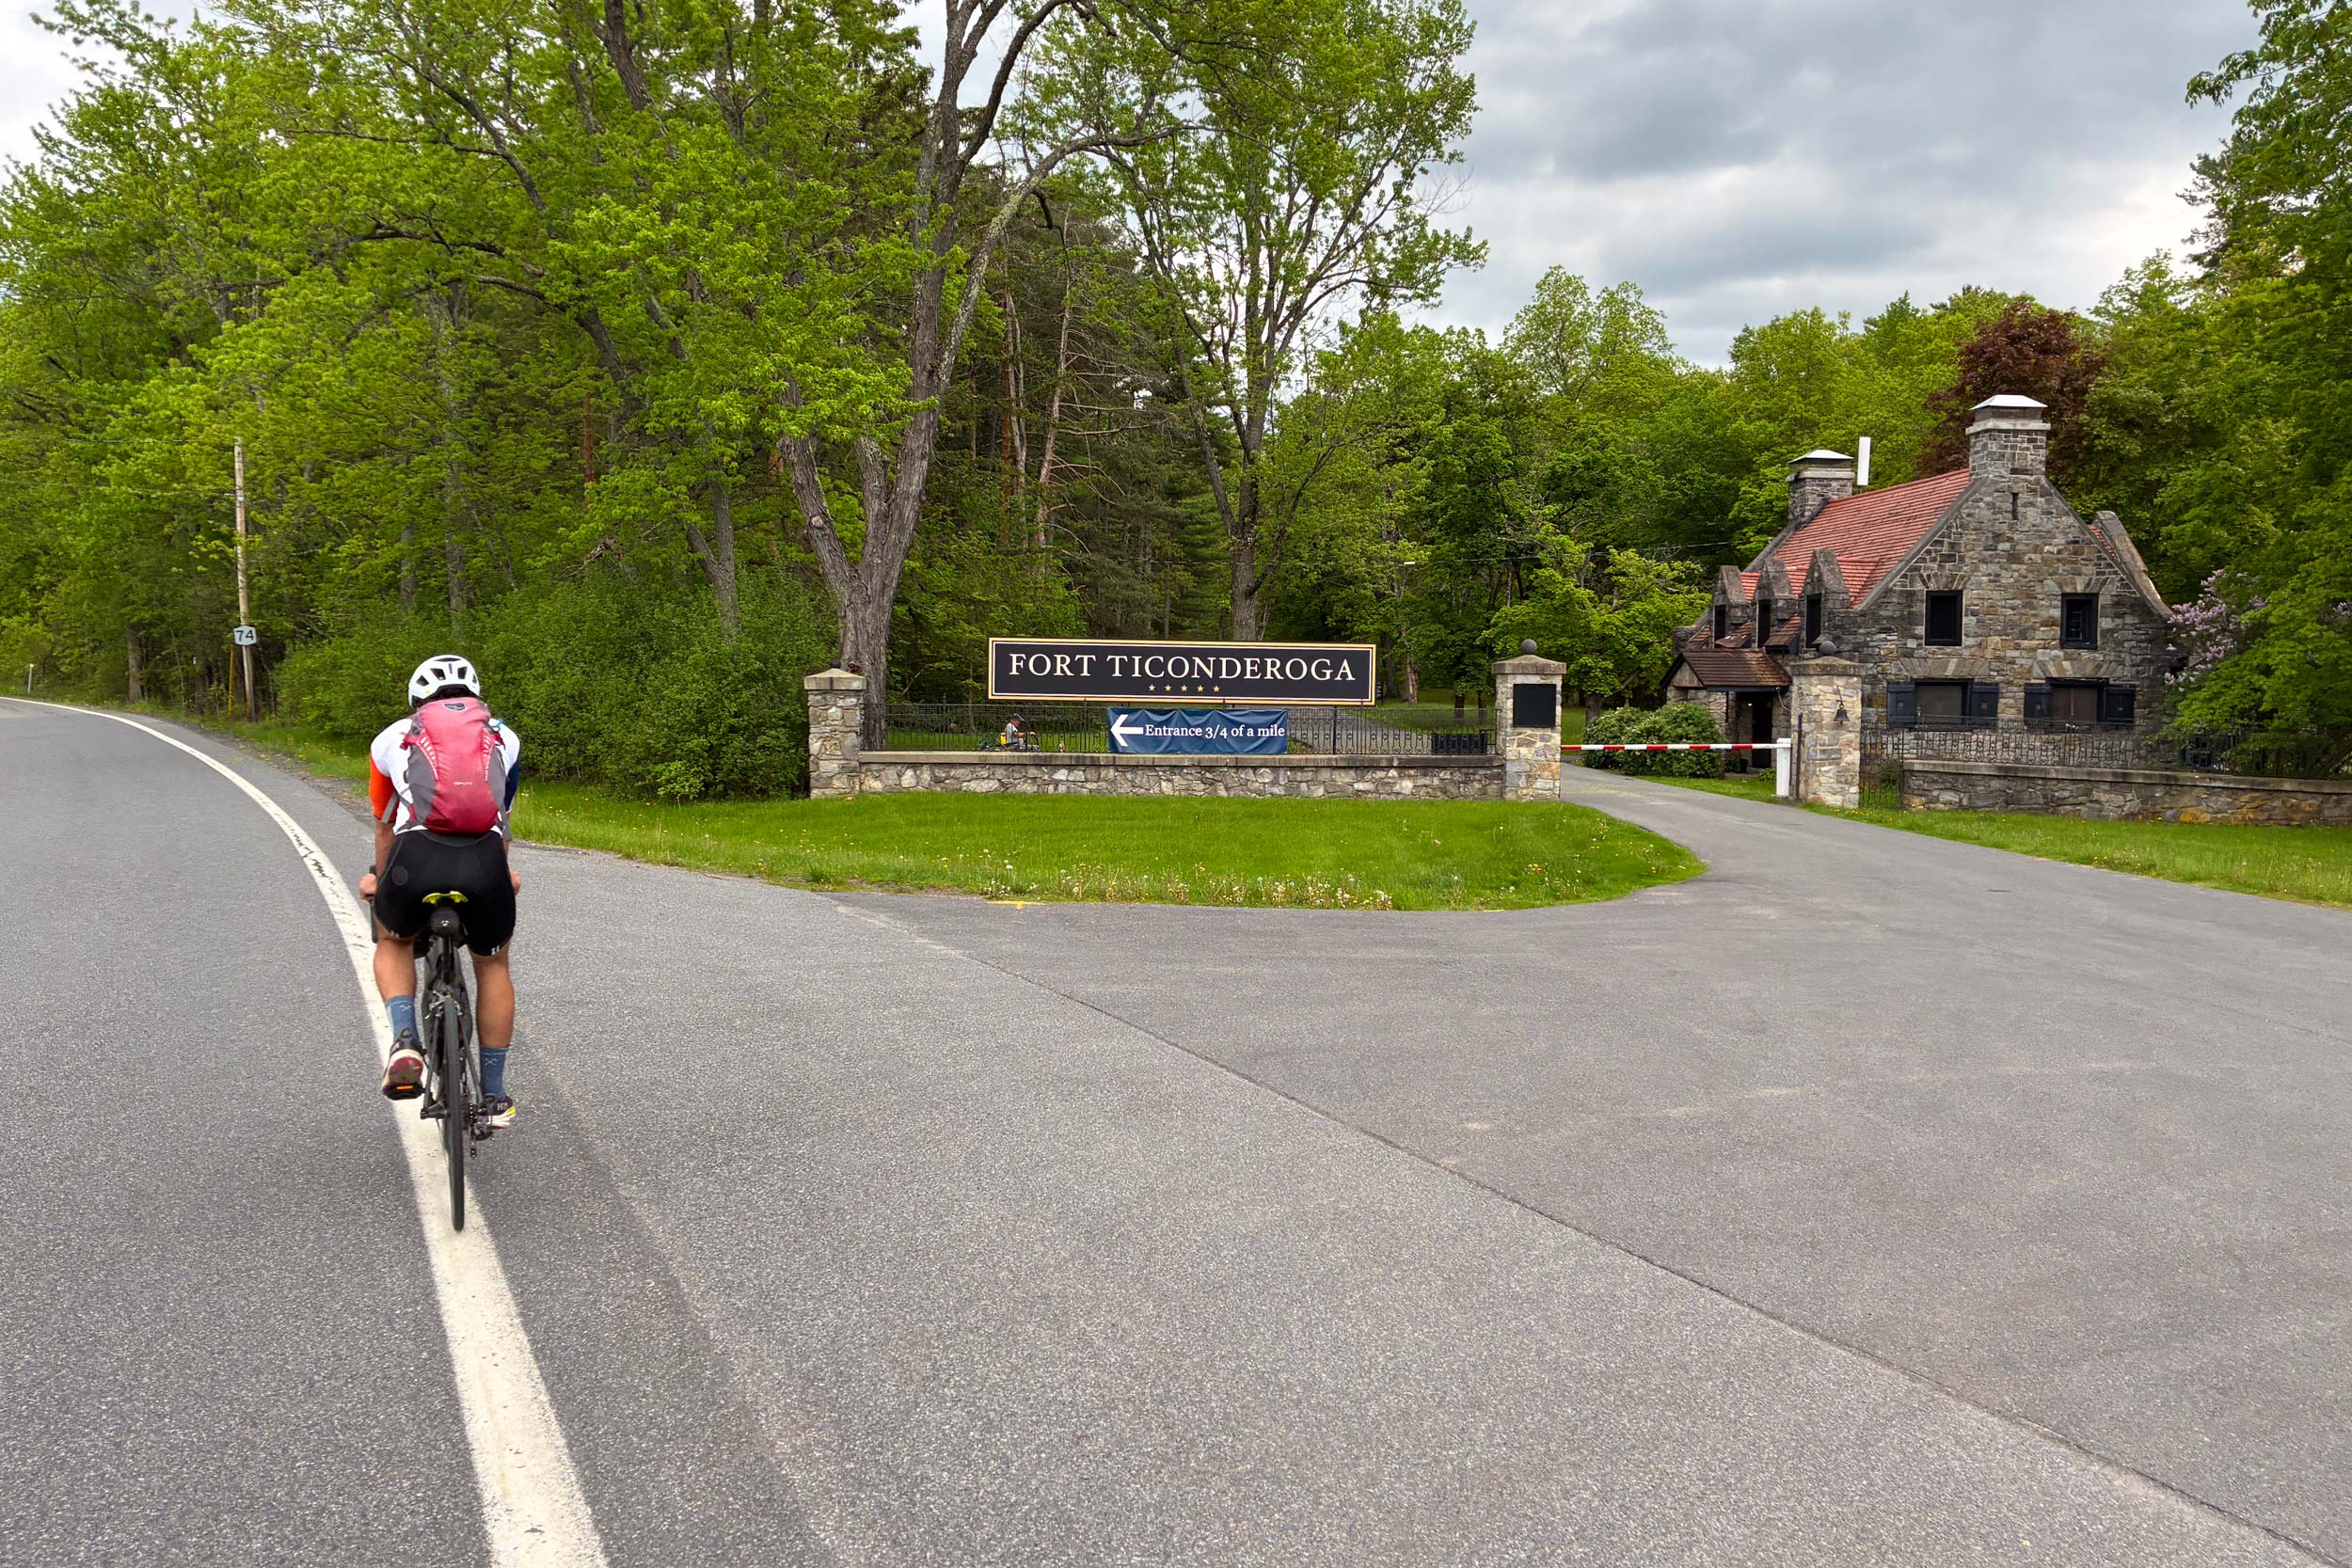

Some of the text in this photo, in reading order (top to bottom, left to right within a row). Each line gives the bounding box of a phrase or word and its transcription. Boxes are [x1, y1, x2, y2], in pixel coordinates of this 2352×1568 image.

[235, 629, 254, 641] 74
[1009, 653, 1356, 681] FORT TICONDEROGA
[1145, 724, 1285, 739] Entrance 3/4 of a mile
